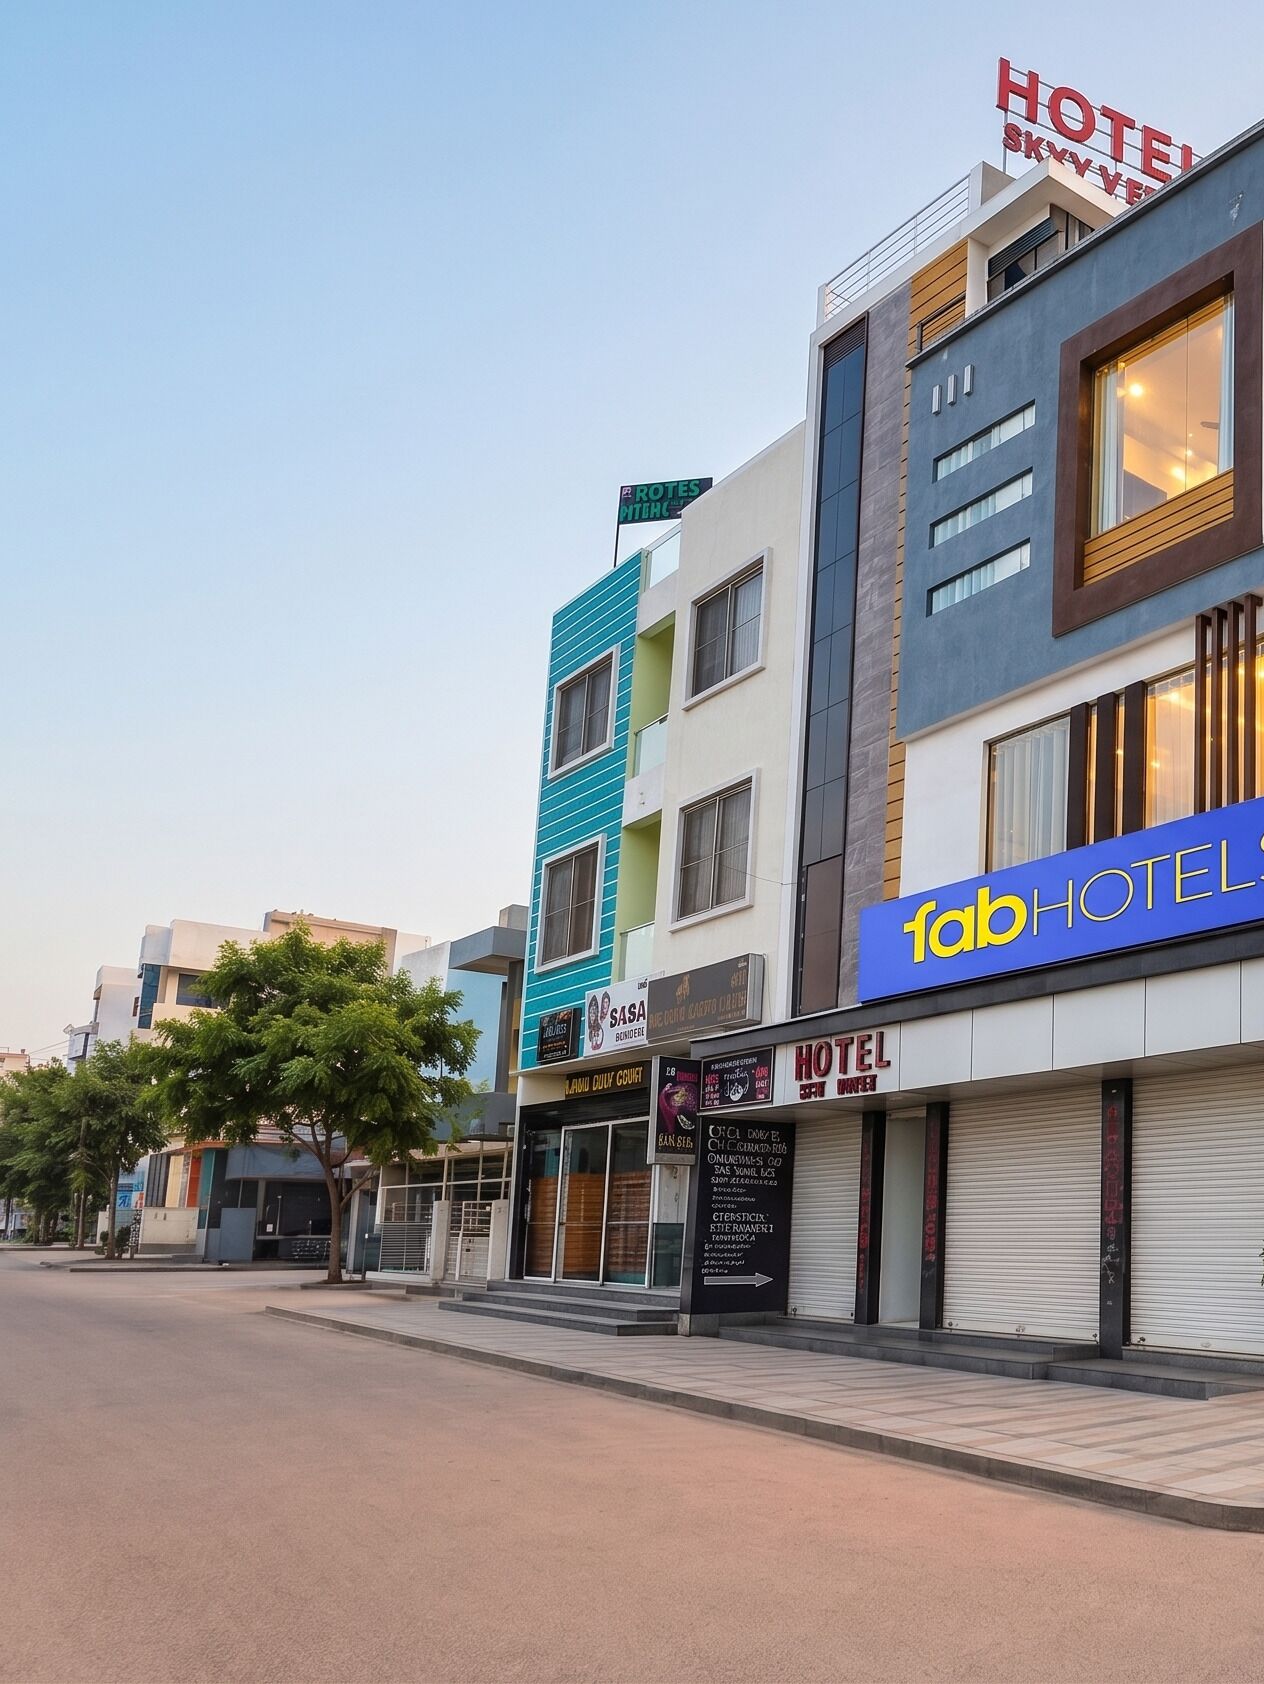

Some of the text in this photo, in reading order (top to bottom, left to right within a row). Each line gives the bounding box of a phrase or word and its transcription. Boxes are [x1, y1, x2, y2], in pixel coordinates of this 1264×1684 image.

[635, 480, 701, 502] ROTES
[609, 1000, 647, 1029] SASA
[794, 1031, 892, 1082] HOTEL
